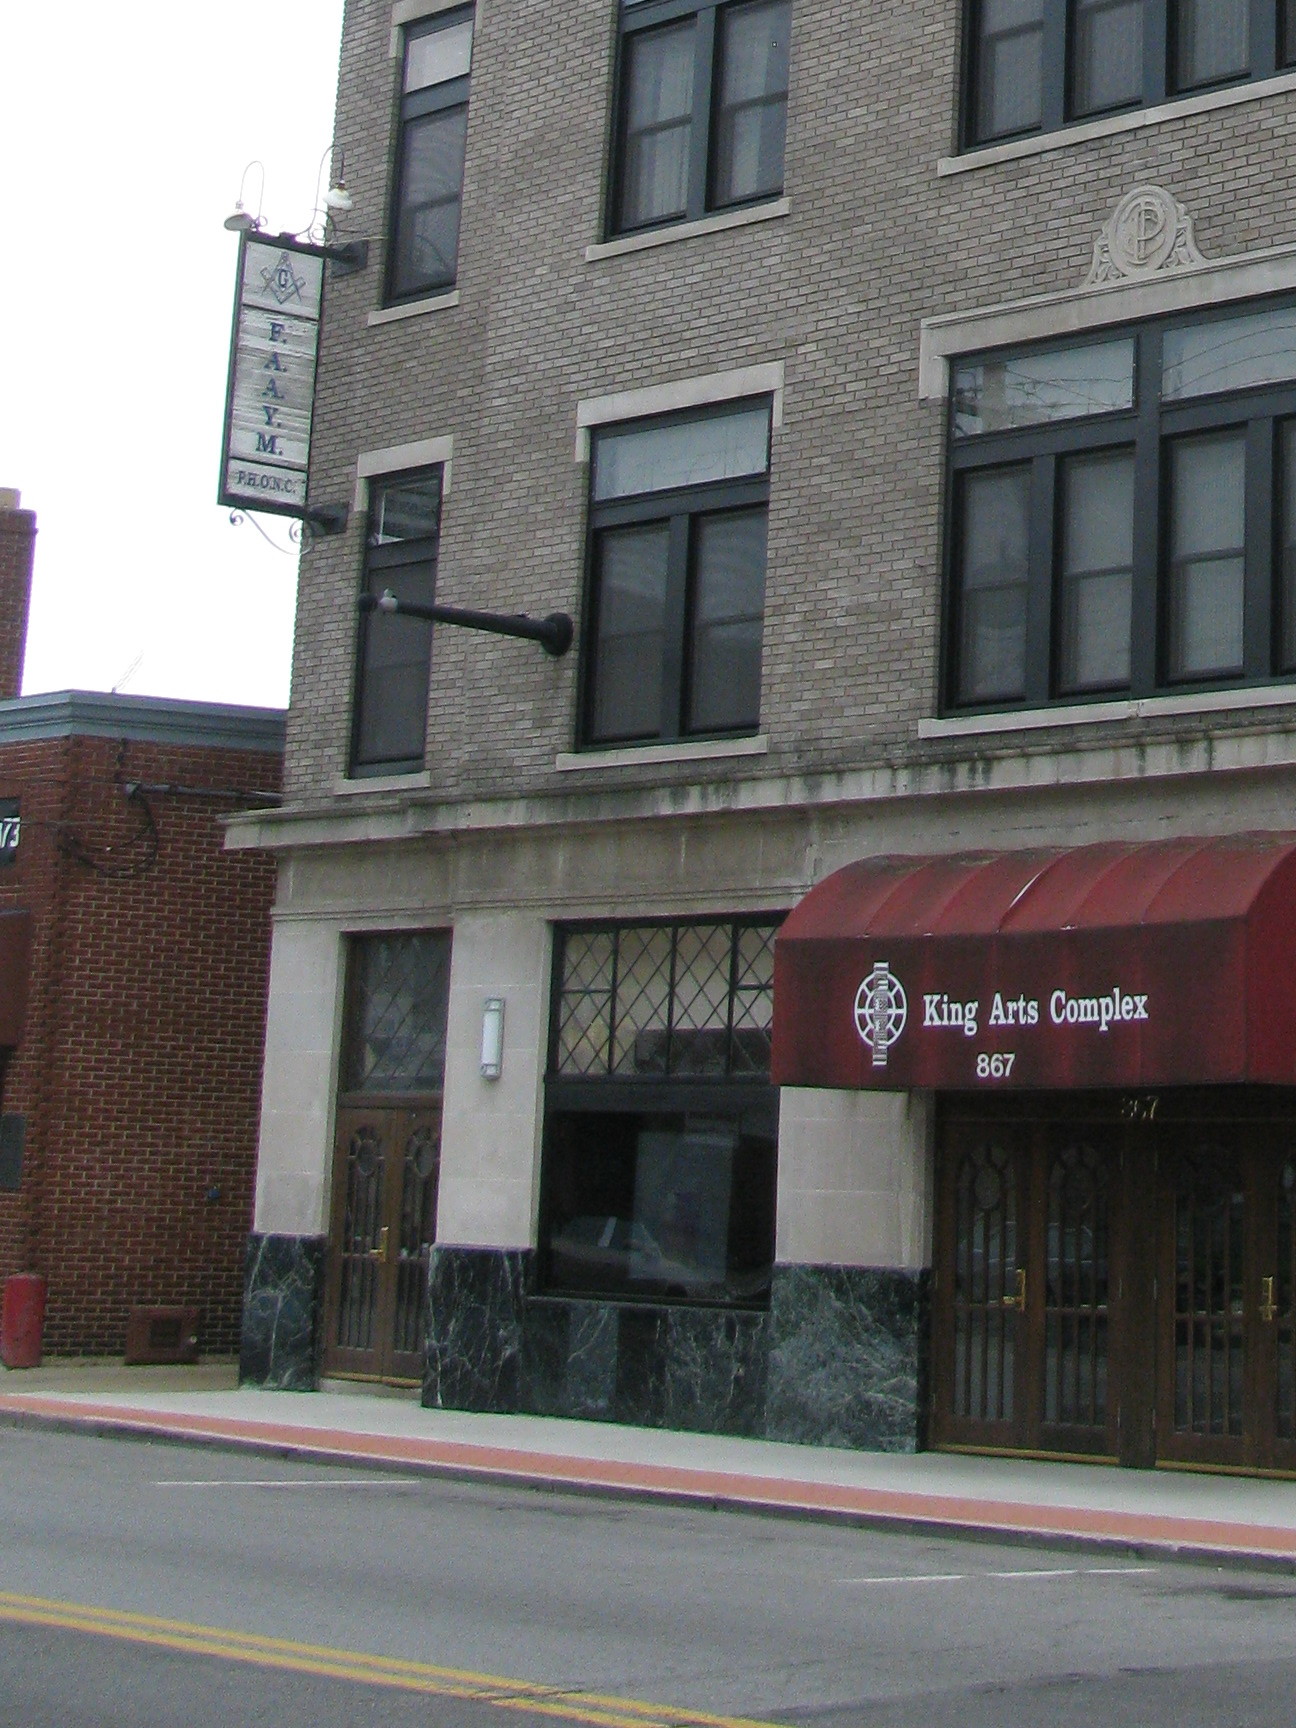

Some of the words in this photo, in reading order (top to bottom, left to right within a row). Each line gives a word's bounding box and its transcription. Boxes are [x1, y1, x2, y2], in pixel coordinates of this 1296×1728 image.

[0, 817, 21, 849] 73
[922, 993, 979, 1036] King
[988, 991, 1039, 1025] Arts
[1049, 986, 1149, 1032] Complex
[976, 1052, 1016, 1078] 867
